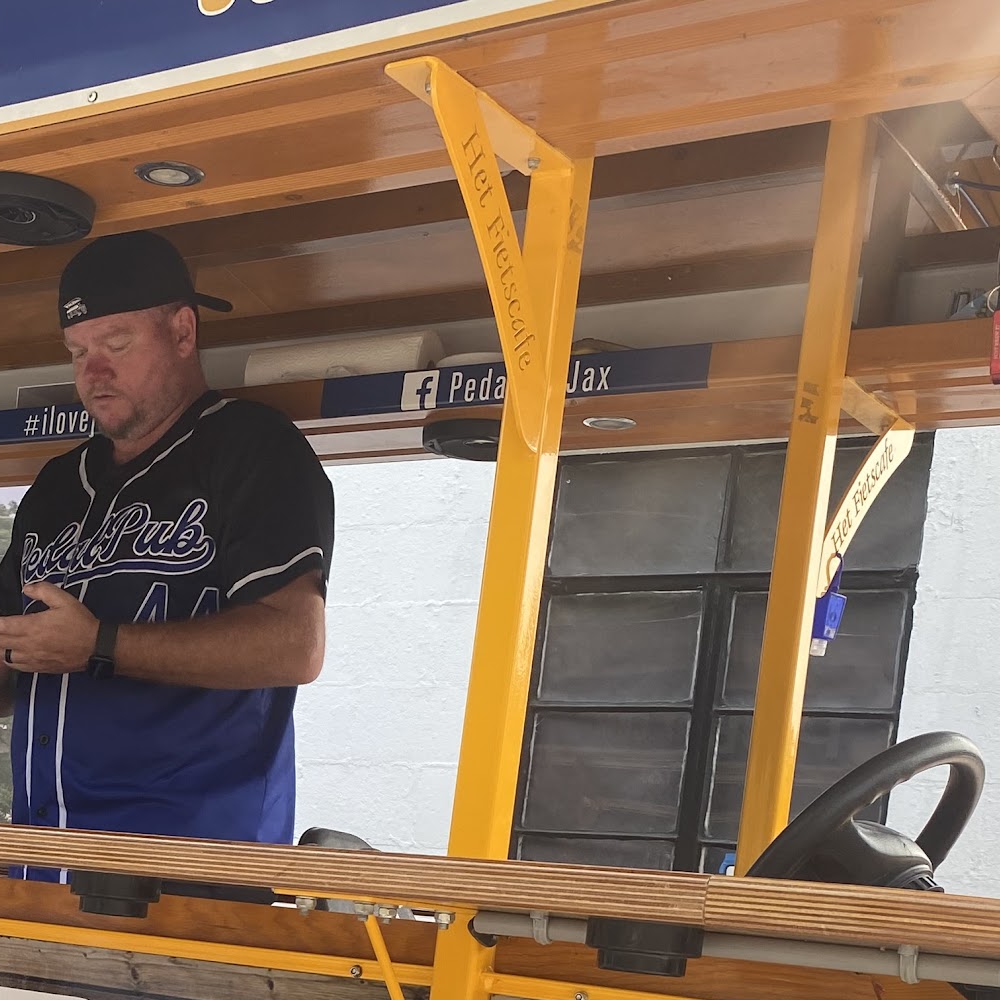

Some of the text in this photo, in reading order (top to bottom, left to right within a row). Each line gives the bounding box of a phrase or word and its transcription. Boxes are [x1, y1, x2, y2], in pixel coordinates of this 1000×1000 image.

[461, 125, 536, 372] Het Fietscafe
[104, 499, 208, 562] Pub
[831, 438, 894, 553] Het Fietscafe
